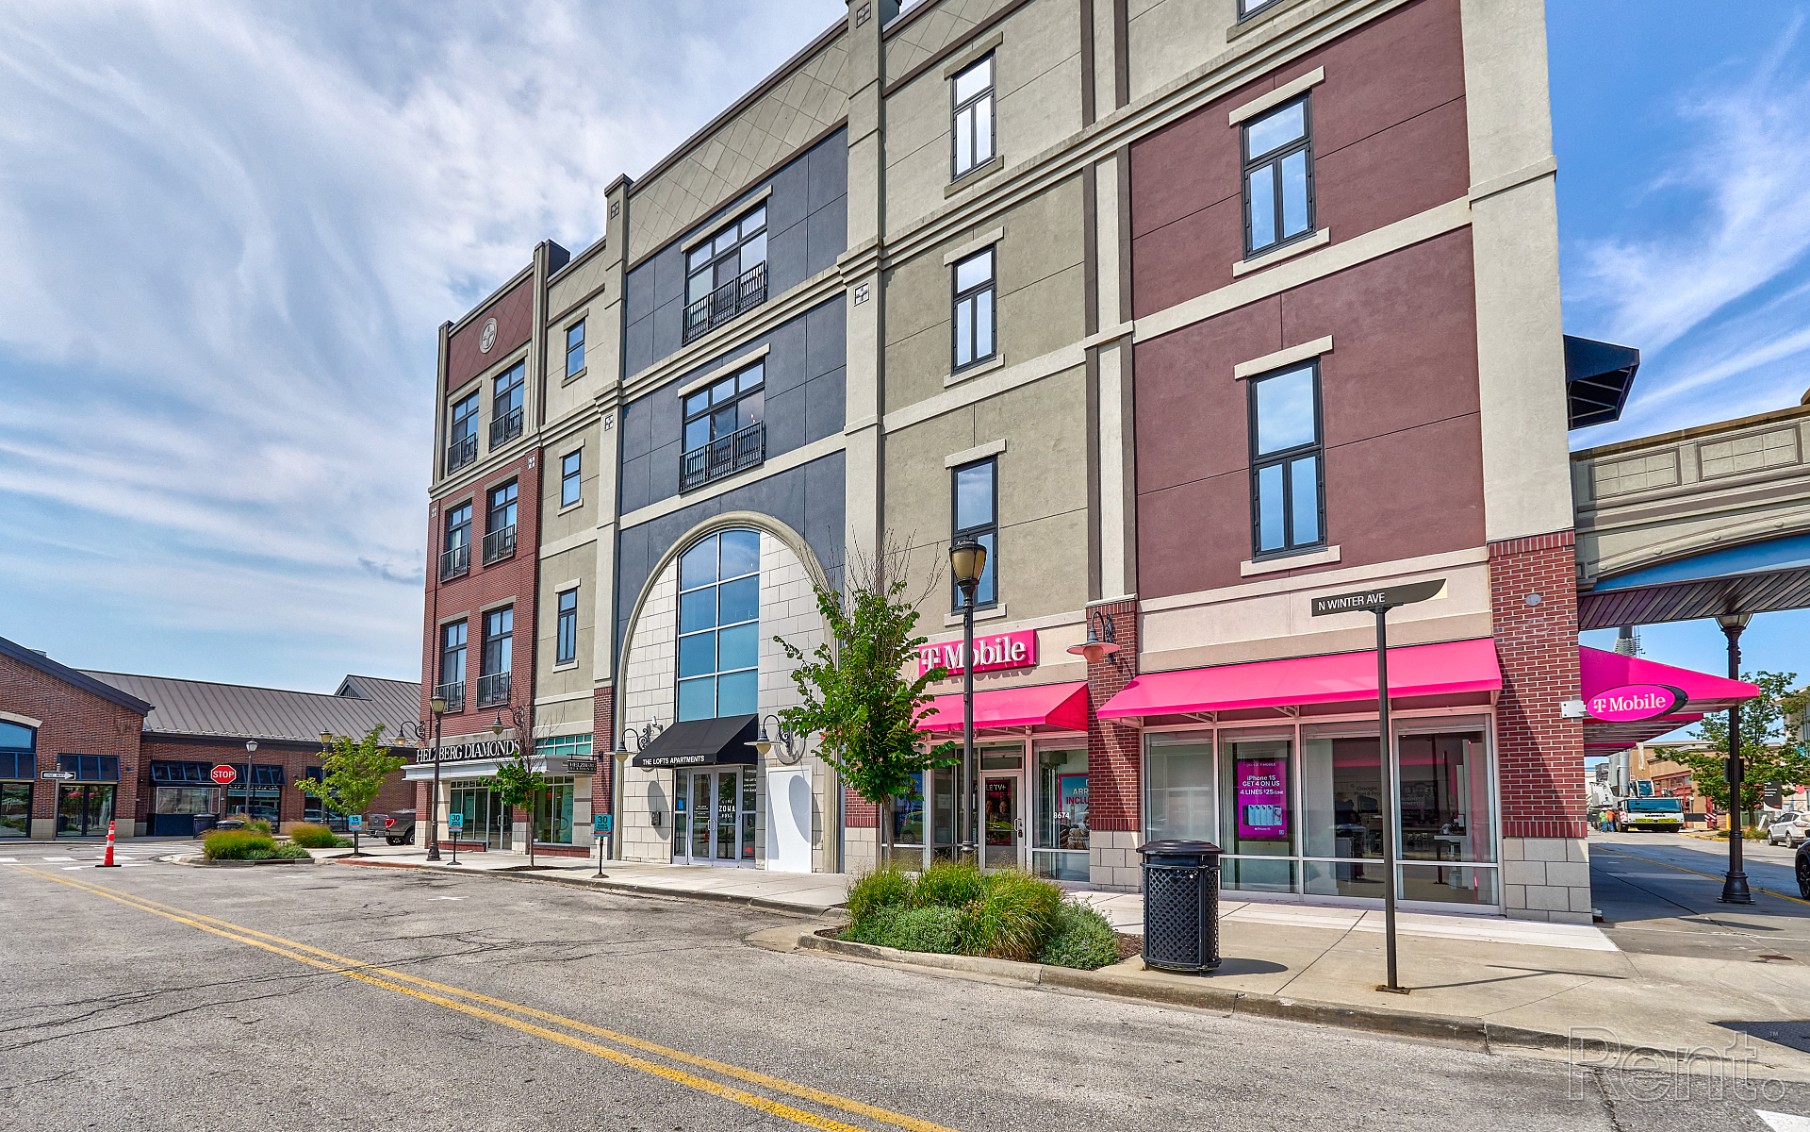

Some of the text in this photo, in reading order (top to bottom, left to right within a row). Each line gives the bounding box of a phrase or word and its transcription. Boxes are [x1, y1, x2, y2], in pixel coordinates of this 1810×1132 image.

[1318, 592, 1386, 611] N WINTER AVE
[1593, 693, 1667, 713] T Mobile
[464, 739, 521, 759] DIAMONDS
[642, 754, 705, 766] THE LOFTS APARTMENTS
[212, 770, 235, 779] STOP
[597, 815, 608, 824] 30
